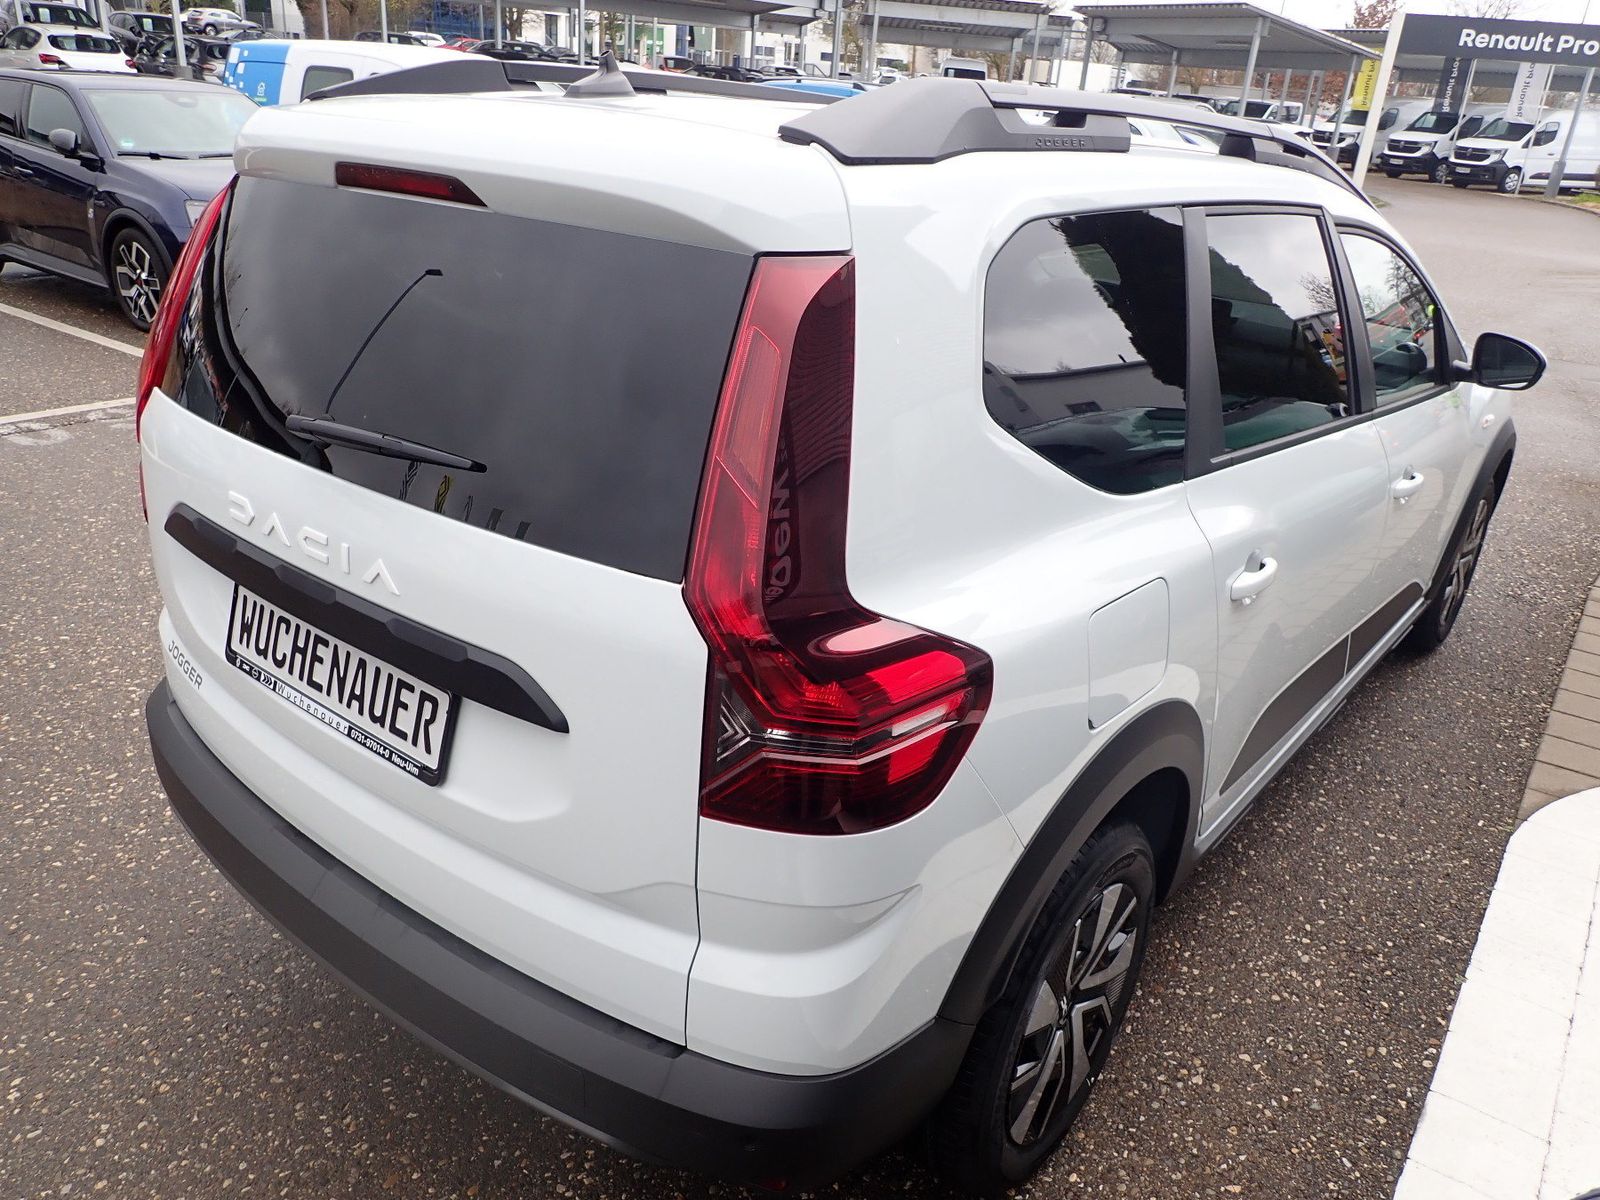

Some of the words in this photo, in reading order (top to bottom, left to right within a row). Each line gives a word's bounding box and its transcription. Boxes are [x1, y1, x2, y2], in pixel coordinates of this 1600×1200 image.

[1459, 28, 1554, 53] Renault
[1556, 35, 1600, 56] Pro
[1035, 137, 1086, 149] JOGGER
[228, 490, 401, 596] DACIA
[168, 640, 203, 690] JOGGER
[239, 594, 439, 755] WUCHENAUER
[391, 752, 419, 776] Neu-Ulm
